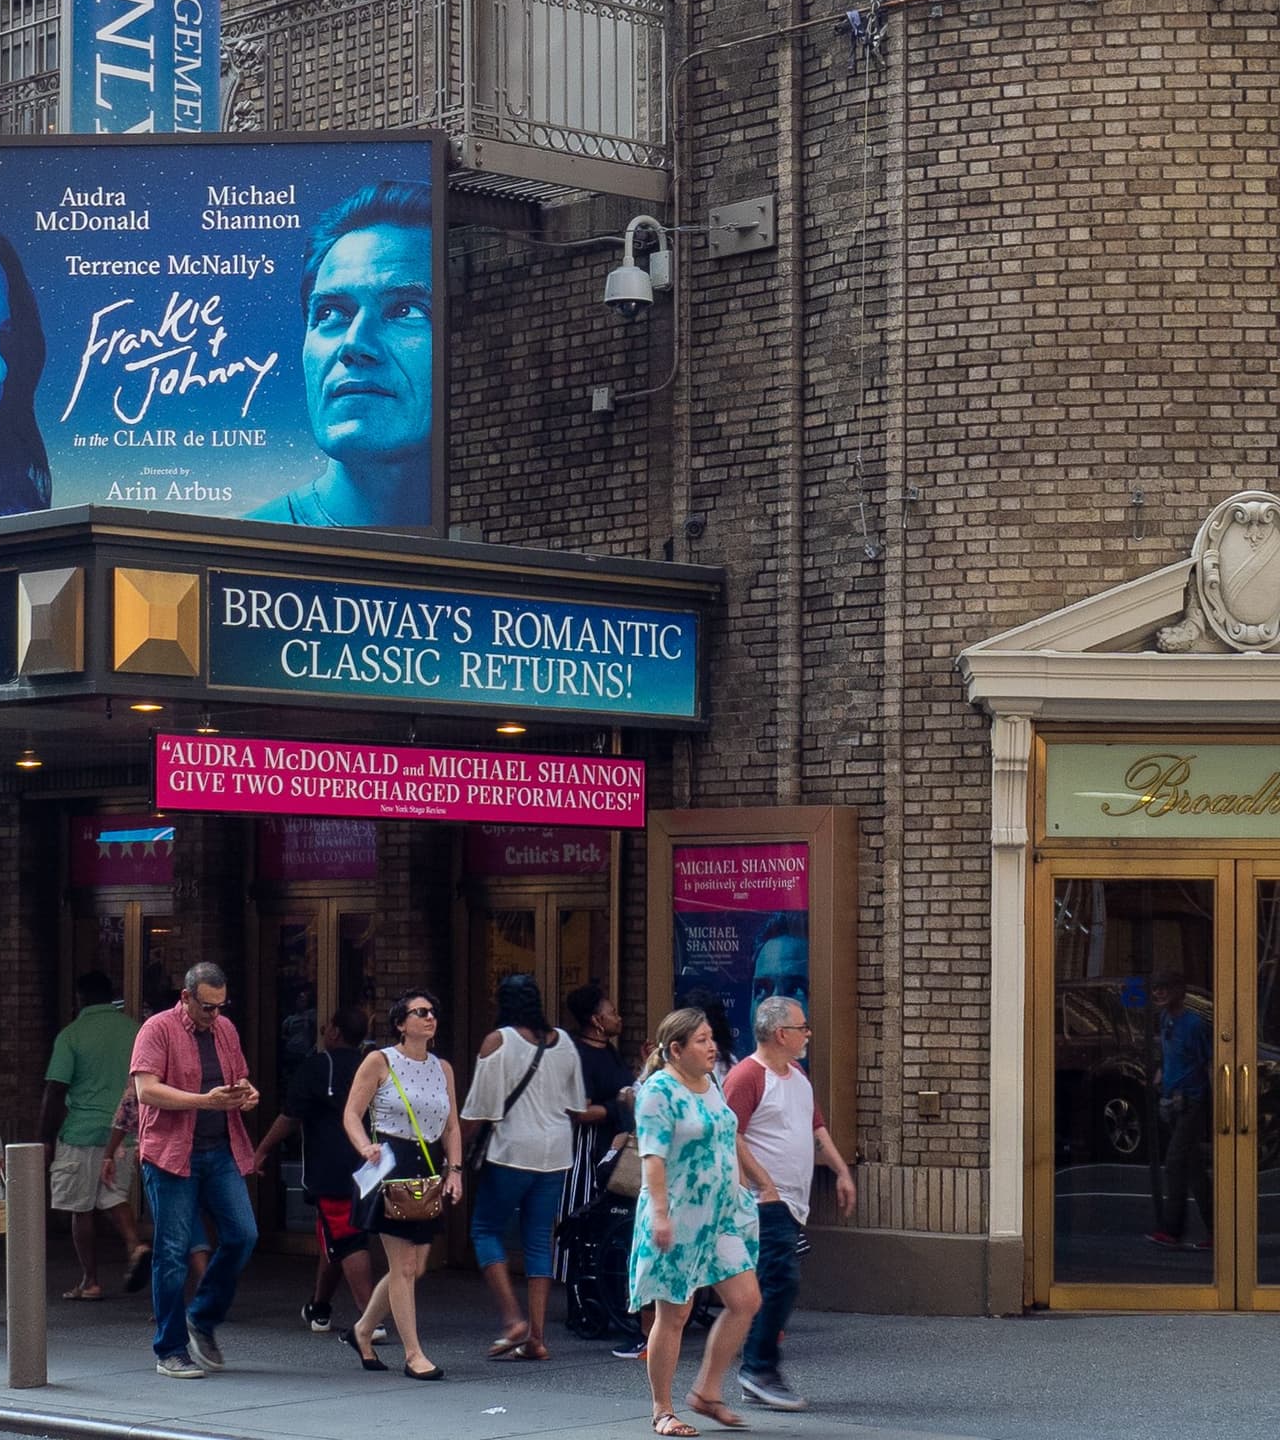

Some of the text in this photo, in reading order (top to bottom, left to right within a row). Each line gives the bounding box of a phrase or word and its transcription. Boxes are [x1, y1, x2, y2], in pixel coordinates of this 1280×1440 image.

[59, 186, 127, 209] Audra
[207, 185, 296, 207] Michael
[35, 210, 151, 232] McDonald
[201, 210, 301, 232] Shannon
[65, 254, 275, 280] Terrence McNally's
[60, 290, 224, 423] Frankie
[113, 350, 280, 425] Johnny
[73, 429, 268, 448] in the CLAIR de LUNE
[142, 466, 176, 477] Directed
[105, 480, 233, 502] Arin Arbus
[222, 586, 684, 661] BROADWAY’S ROMANTIC
[280, 638, 634, 700] CLASSIC RETURNS!
[161, 741, 642, 788] “AUDRA McDONALD and MICHAEL SHANNON
[168, 768, 641, 812] GIVE TWO SUPERCHARGED PERFORMANCES!”
[380, 803, 394, 813] New
[395, 804, 408, 814] York
[322, 849, 377, 864] CONNECTI
[505, 843, 601, 865] Critic's Pick
[742, 857, 805, 874] SHANNON
[684, 879, 692, 891] is
[694, 878, 737, 893] positively
[686, 940, 740, 953] SHANNON
